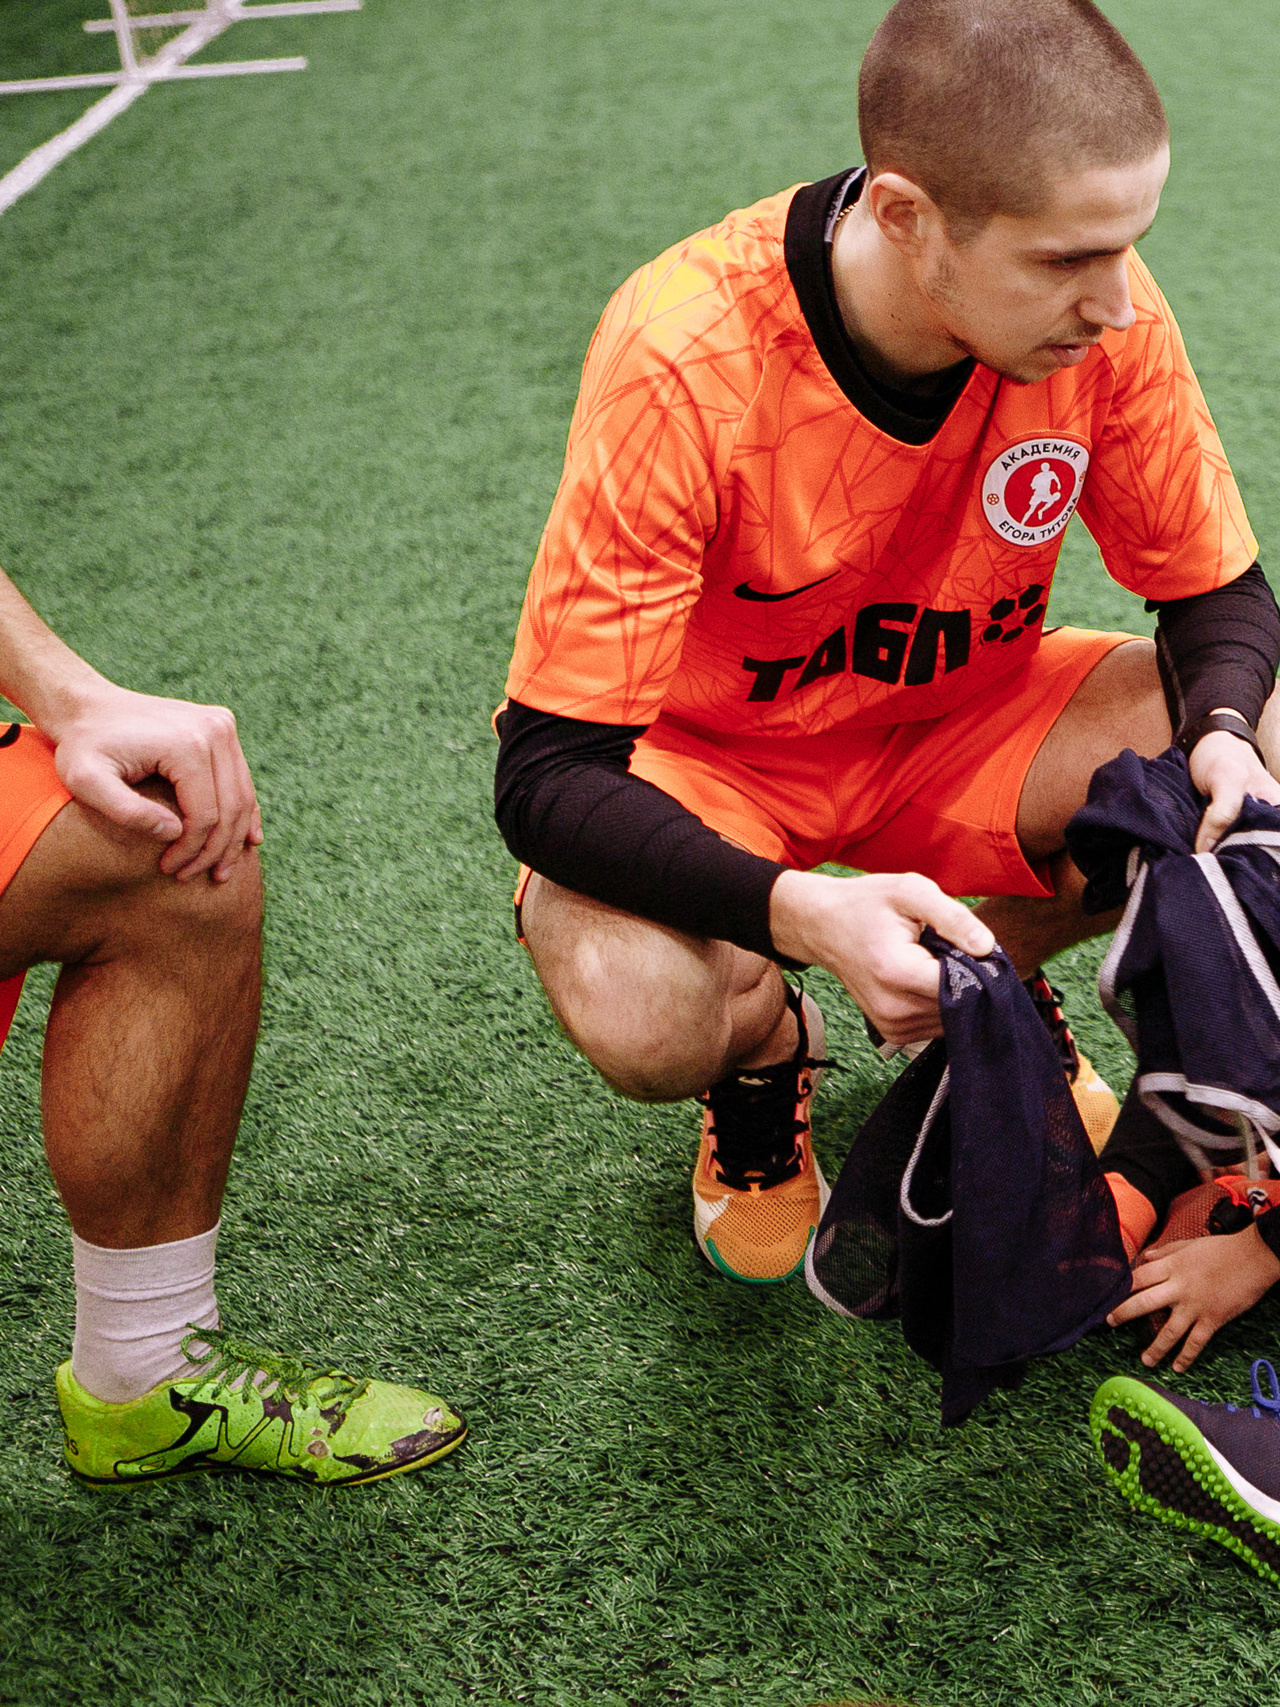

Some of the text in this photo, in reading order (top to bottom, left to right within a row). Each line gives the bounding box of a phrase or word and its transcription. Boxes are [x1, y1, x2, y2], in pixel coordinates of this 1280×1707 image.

[1000, 442, 1081, 472] АКАДЕМИЯ
[998, 496, 1079, 541] ЕГОРА ТИТОВА
